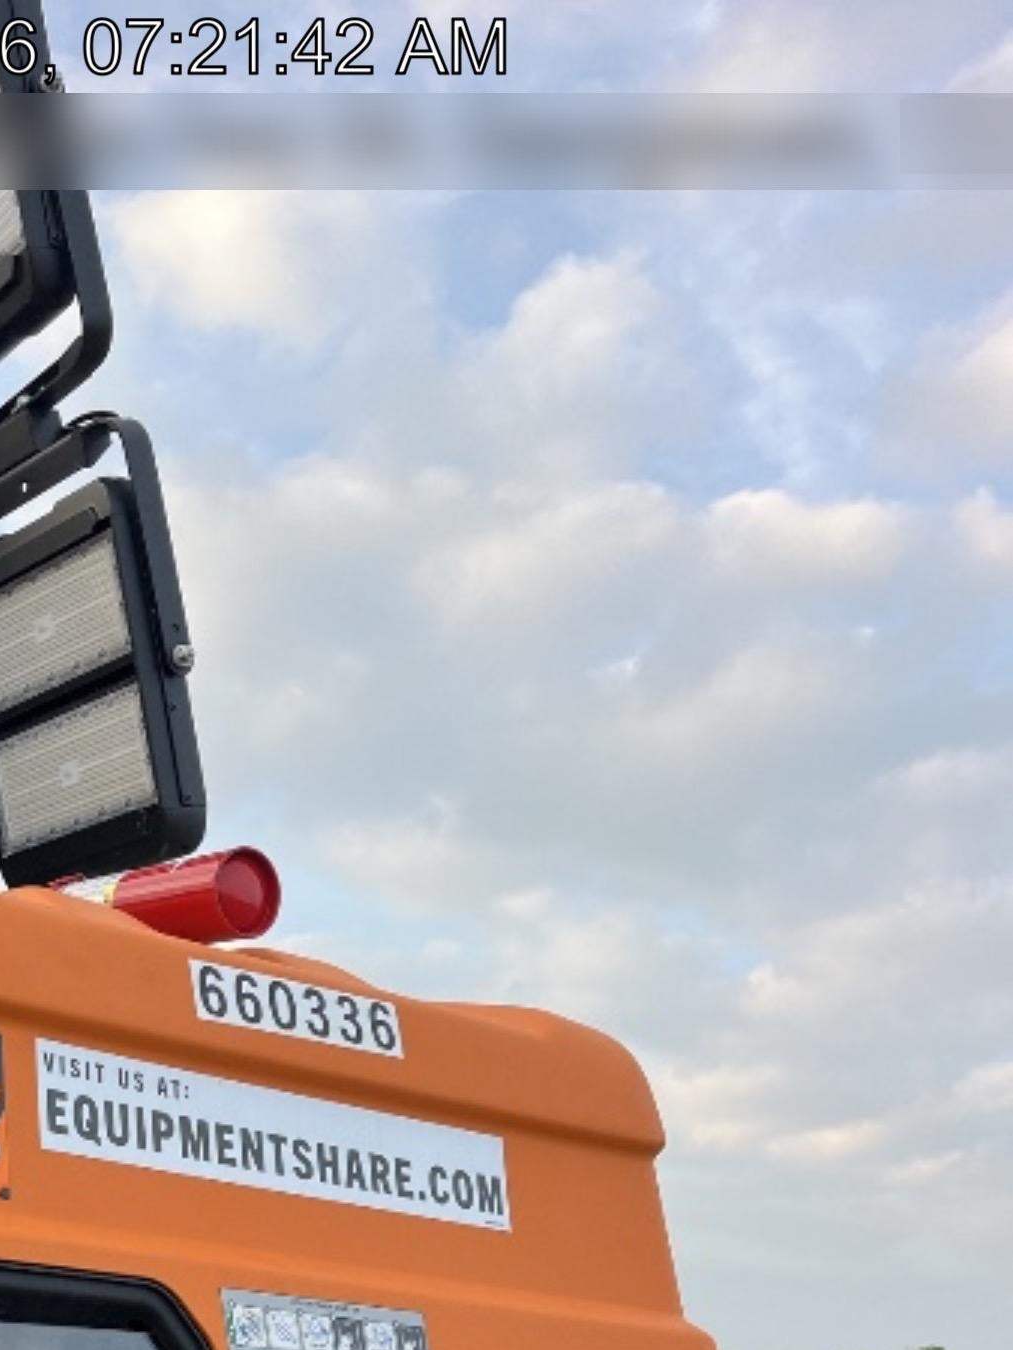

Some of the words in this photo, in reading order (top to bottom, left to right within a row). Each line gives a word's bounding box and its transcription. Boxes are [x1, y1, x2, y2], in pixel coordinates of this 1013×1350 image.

[199, 965, 398, 1051] 660336
[43, 1051, 105, 1084] VISIT
[118, 1067, 144, 1093] US
[157, 1076, 190, 1100] AT:
[45, 1087, 505, 1217] EQUIPMENTSHARE.COM
